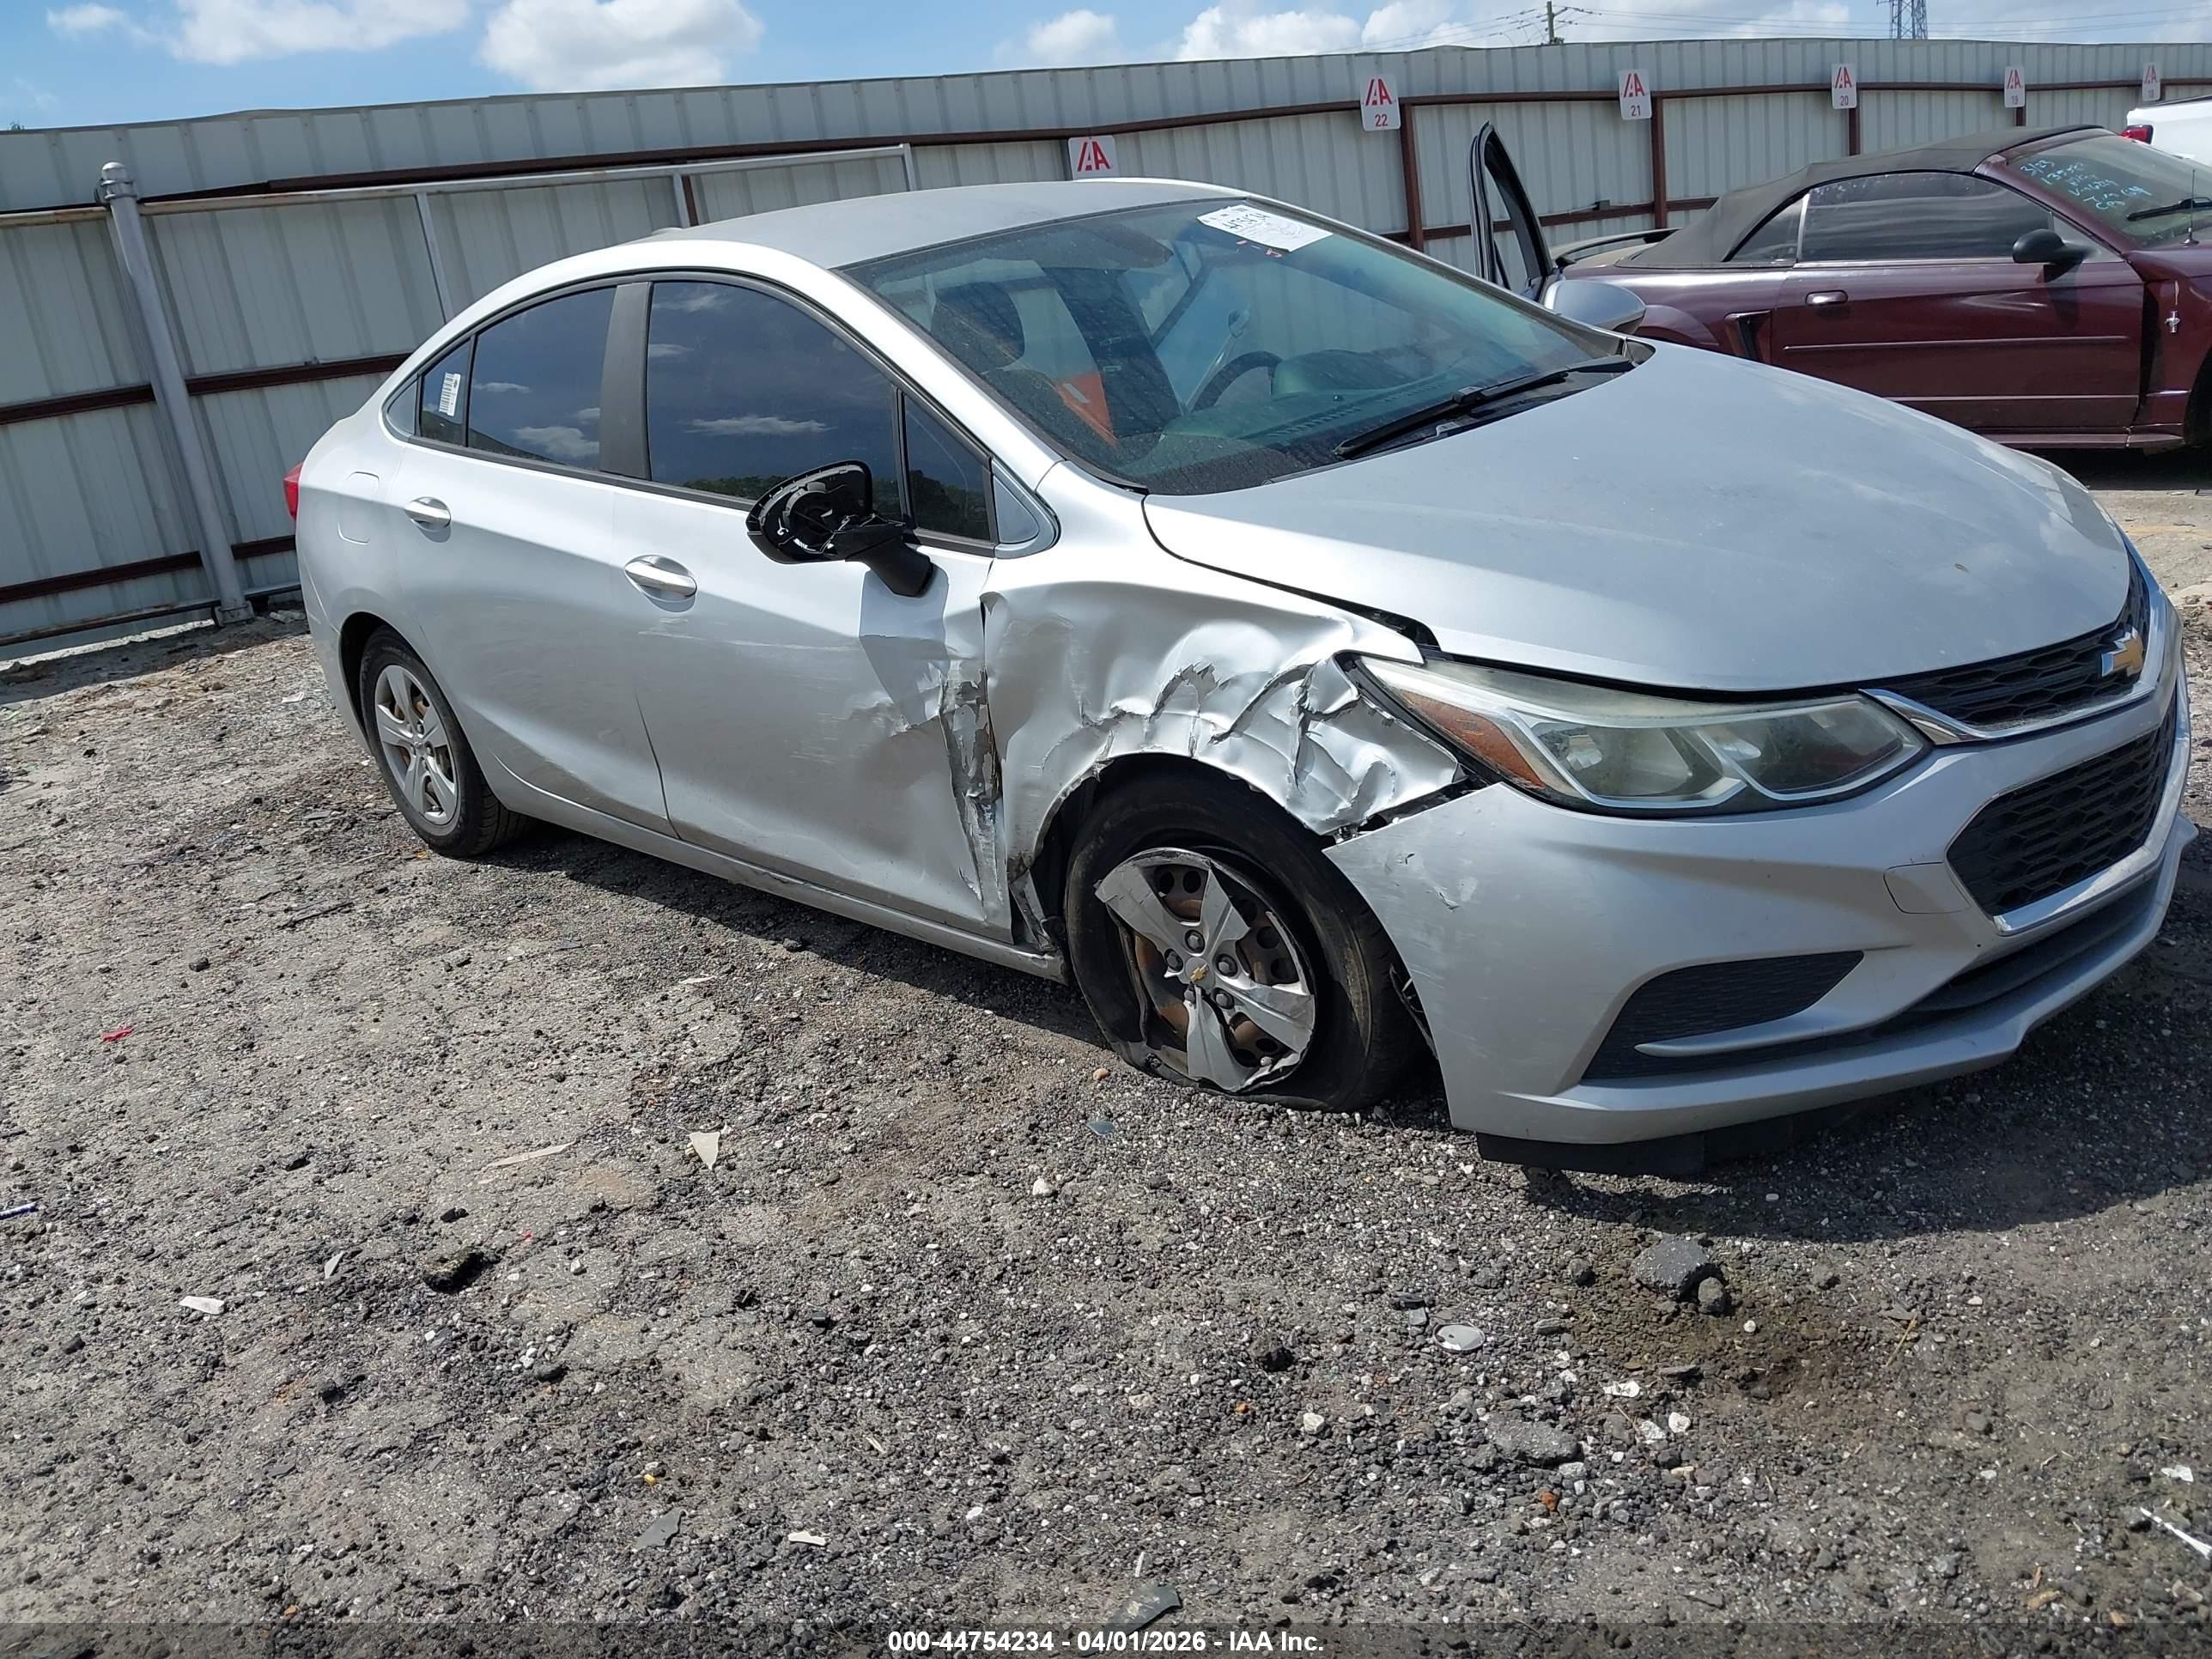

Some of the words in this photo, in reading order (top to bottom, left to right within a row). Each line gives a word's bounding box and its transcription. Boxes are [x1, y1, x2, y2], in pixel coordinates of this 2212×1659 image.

[1840, 95, 1849, 106] 20
[1631, 105, 1641, 117] 21
[1375, 113, 1389, 127] 22
